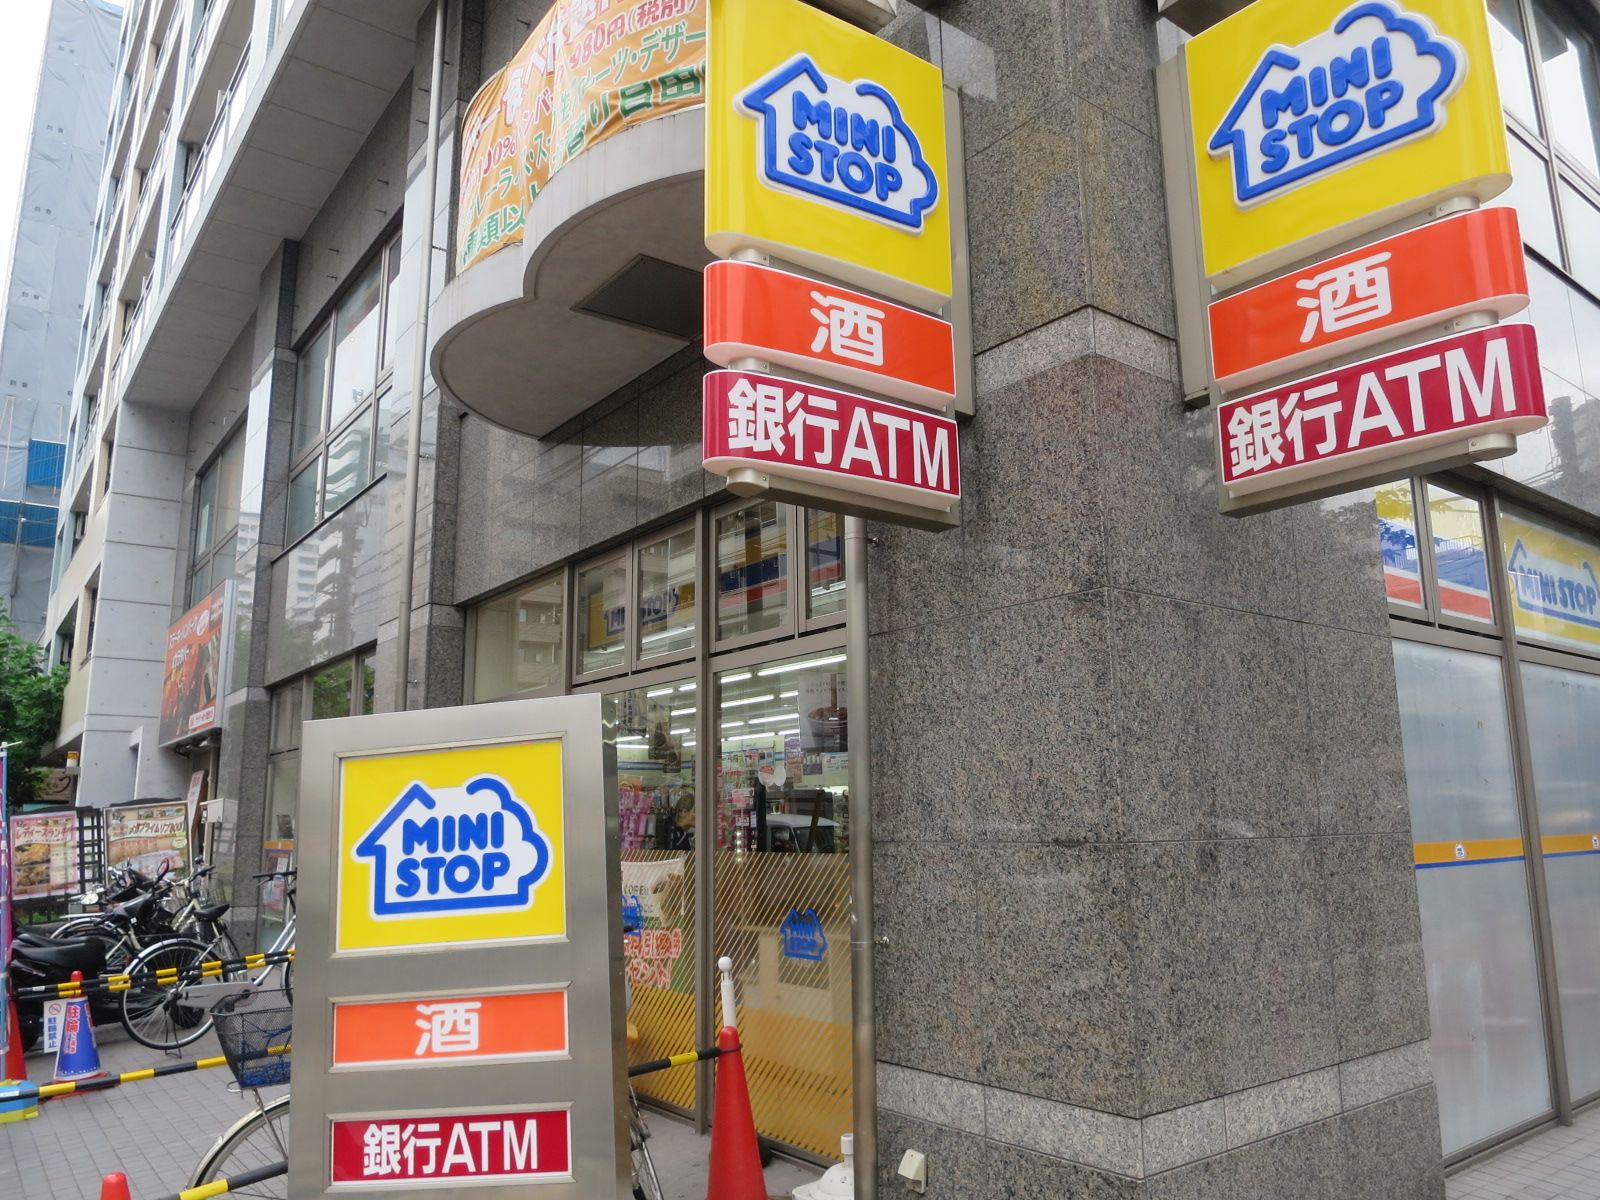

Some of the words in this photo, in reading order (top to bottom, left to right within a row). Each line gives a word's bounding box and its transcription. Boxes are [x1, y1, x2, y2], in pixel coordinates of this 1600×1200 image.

[1260, 36, 1392, 130] MINI
[792, 91, 896, 163] MINI
[1260, 80, 1404, 174] STOP
[788, 132, 903, 201] STOP
[810, 290, 885, 366] 酒
[1296, 251, 1392, 343] 酒
[727, 378, 951, 490] 銀行ATM
[1227, 338, 1516, 478] 銀行ATM
[1558, 576, 1598, 615] STOP
[402, 811, 504, 856] MINI
[396, 852, 510, 898] STOP
[415, 1001, 482, 1056] 酒
[363, 1118, 538, 1176] 銀行ATM
